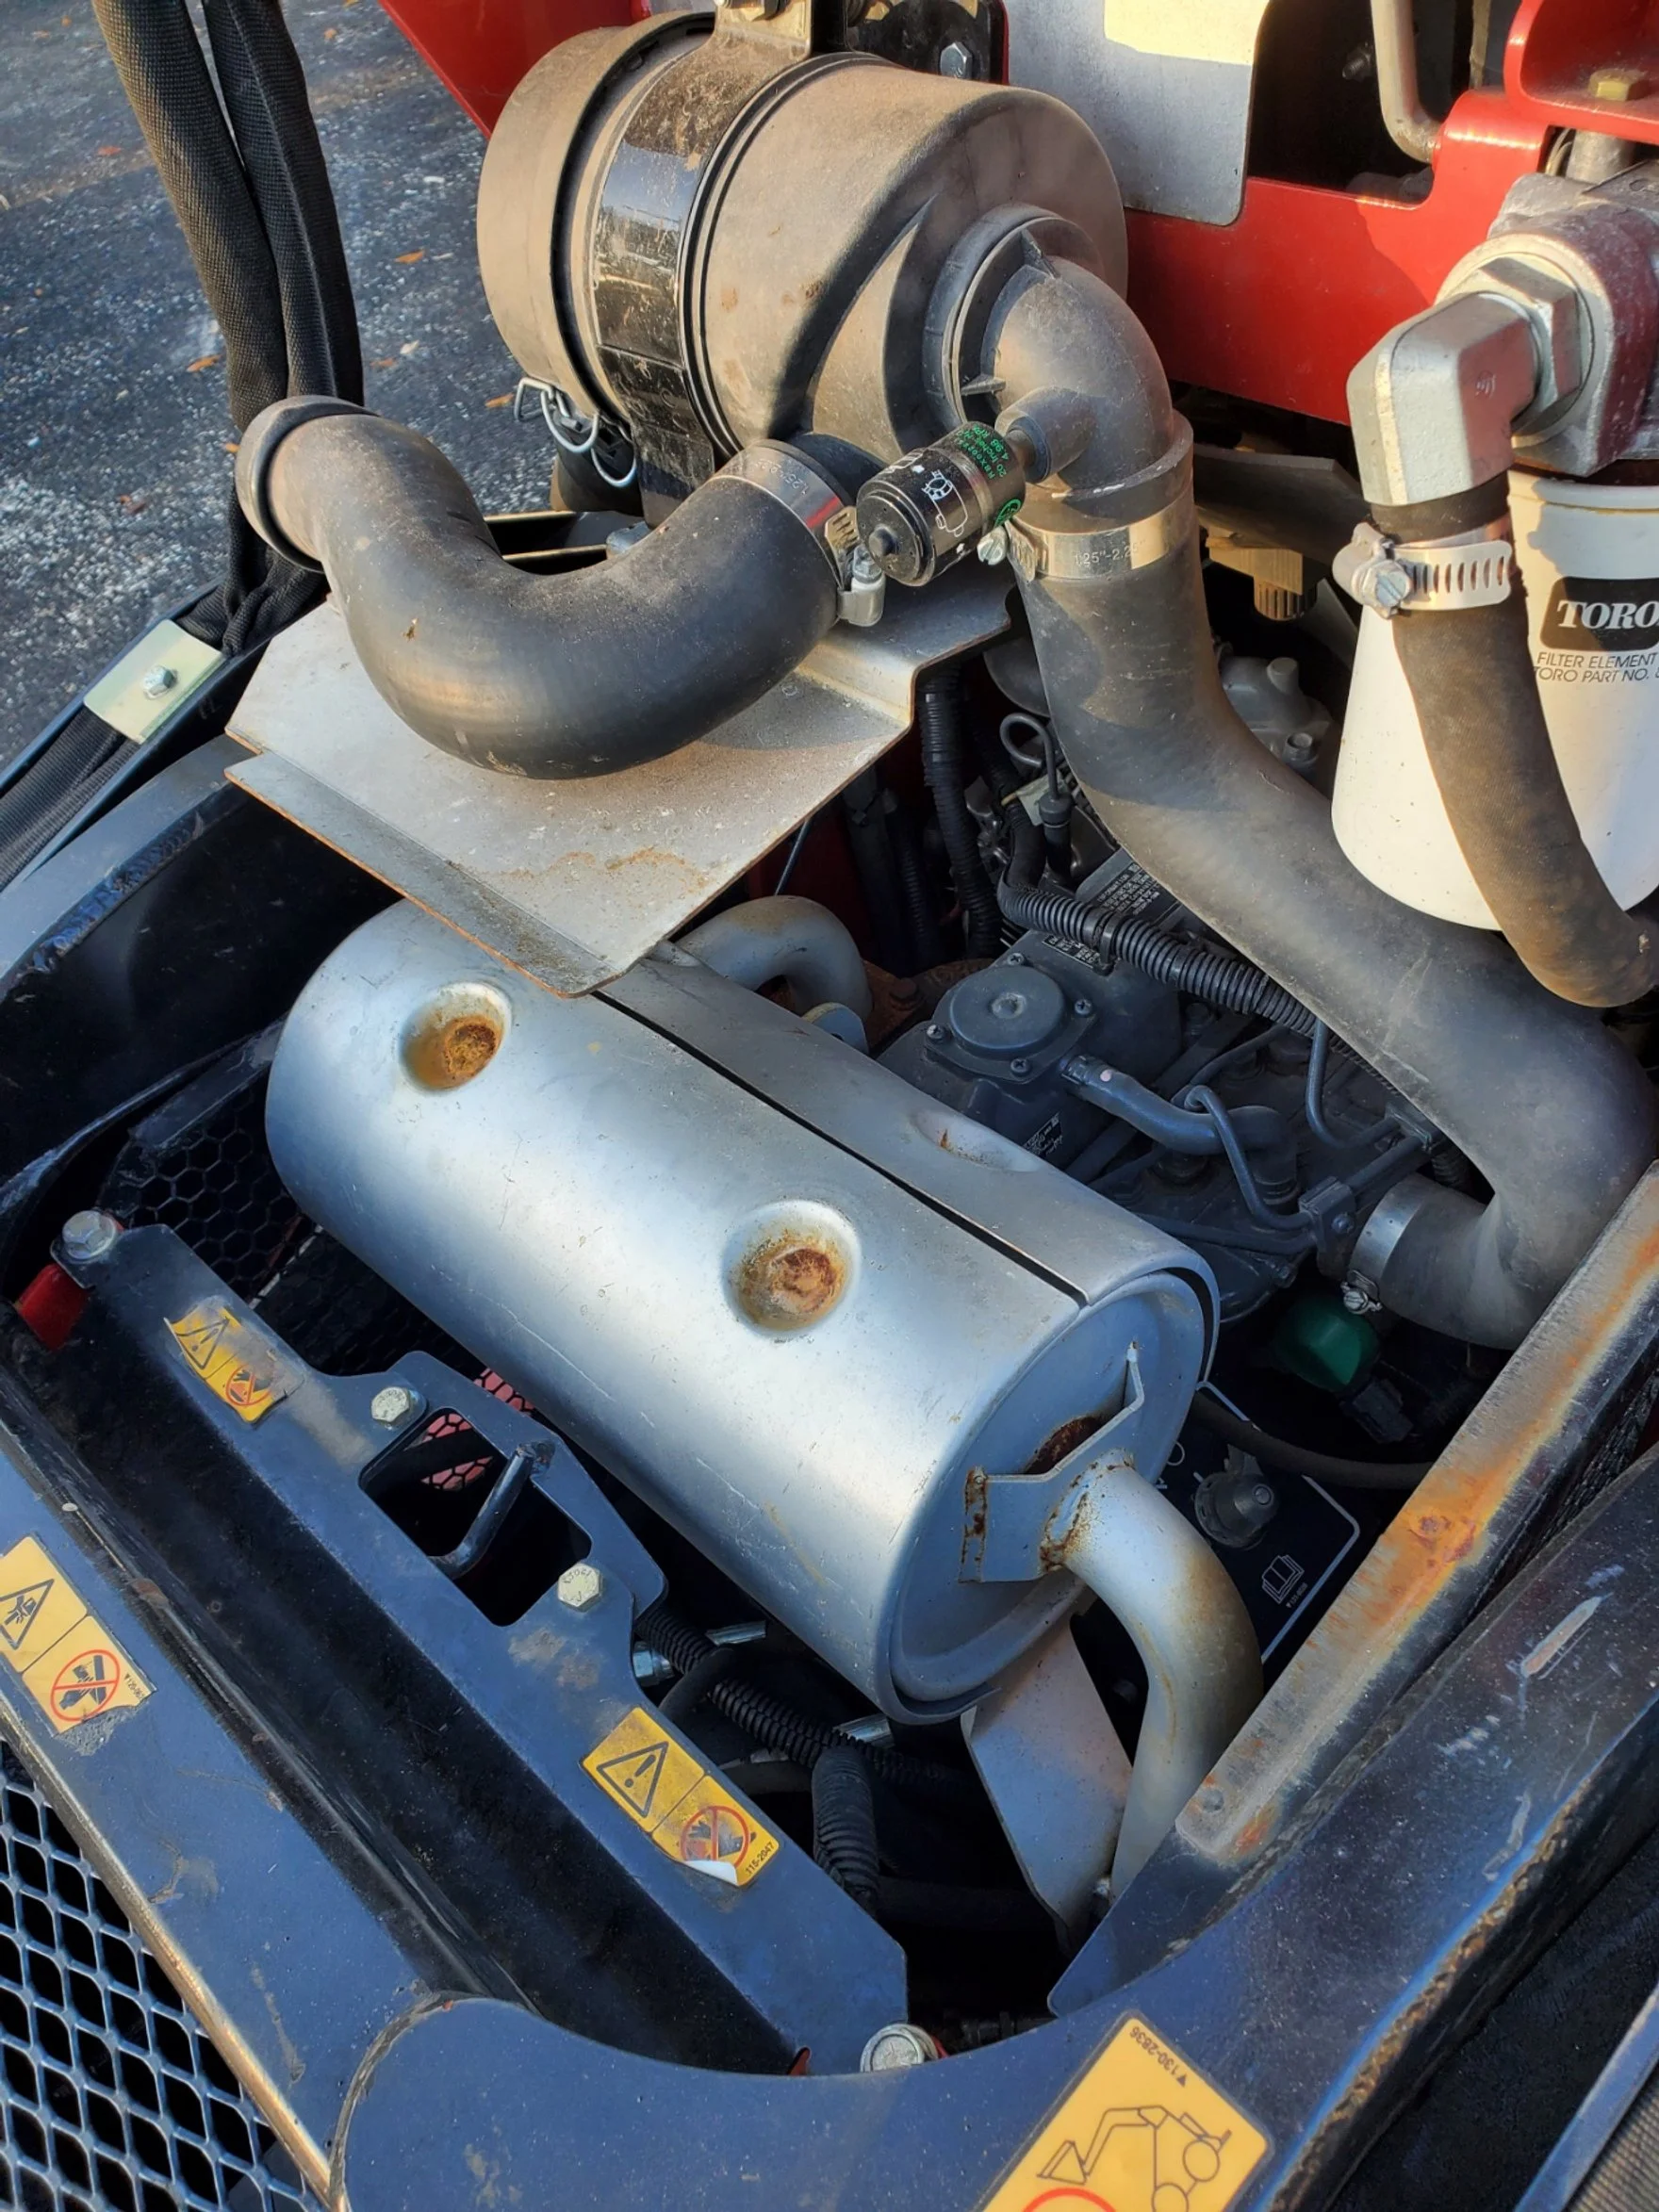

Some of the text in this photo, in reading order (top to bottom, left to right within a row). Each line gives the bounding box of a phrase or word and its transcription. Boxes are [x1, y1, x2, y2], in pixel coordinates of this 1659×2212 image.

[996, 464, 1007, 477] 20
[1557, 600, 1659, 630] TORO
[1537, 651, 1658, 669] FILTER ELEMENT
[1582, 670, 1619, 683] PART
[1621, 667, 1650, 682] NO.
[746, 1842, 774, 1875] 115-2047
[1130, 2025, 1180, 2075] 130-2836
